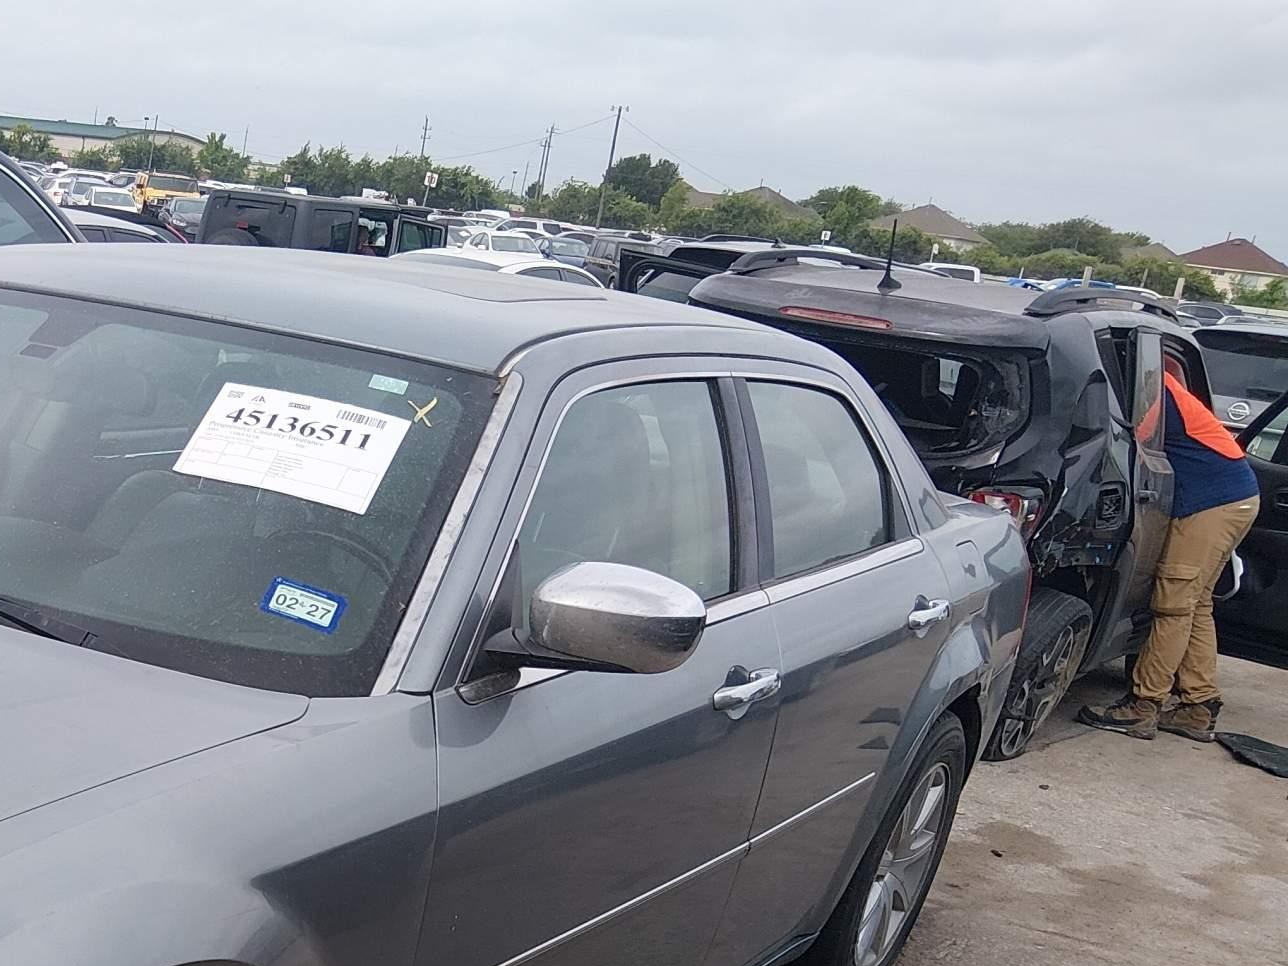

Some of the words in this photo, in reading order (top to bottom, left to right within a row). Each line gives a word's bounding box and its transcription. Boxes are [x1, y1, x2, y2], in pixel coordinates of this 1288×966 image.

[225, 407, 372, 450] 45136511
[275, 593, 299, 610] 02
[305, 604, 332, 620] 27
